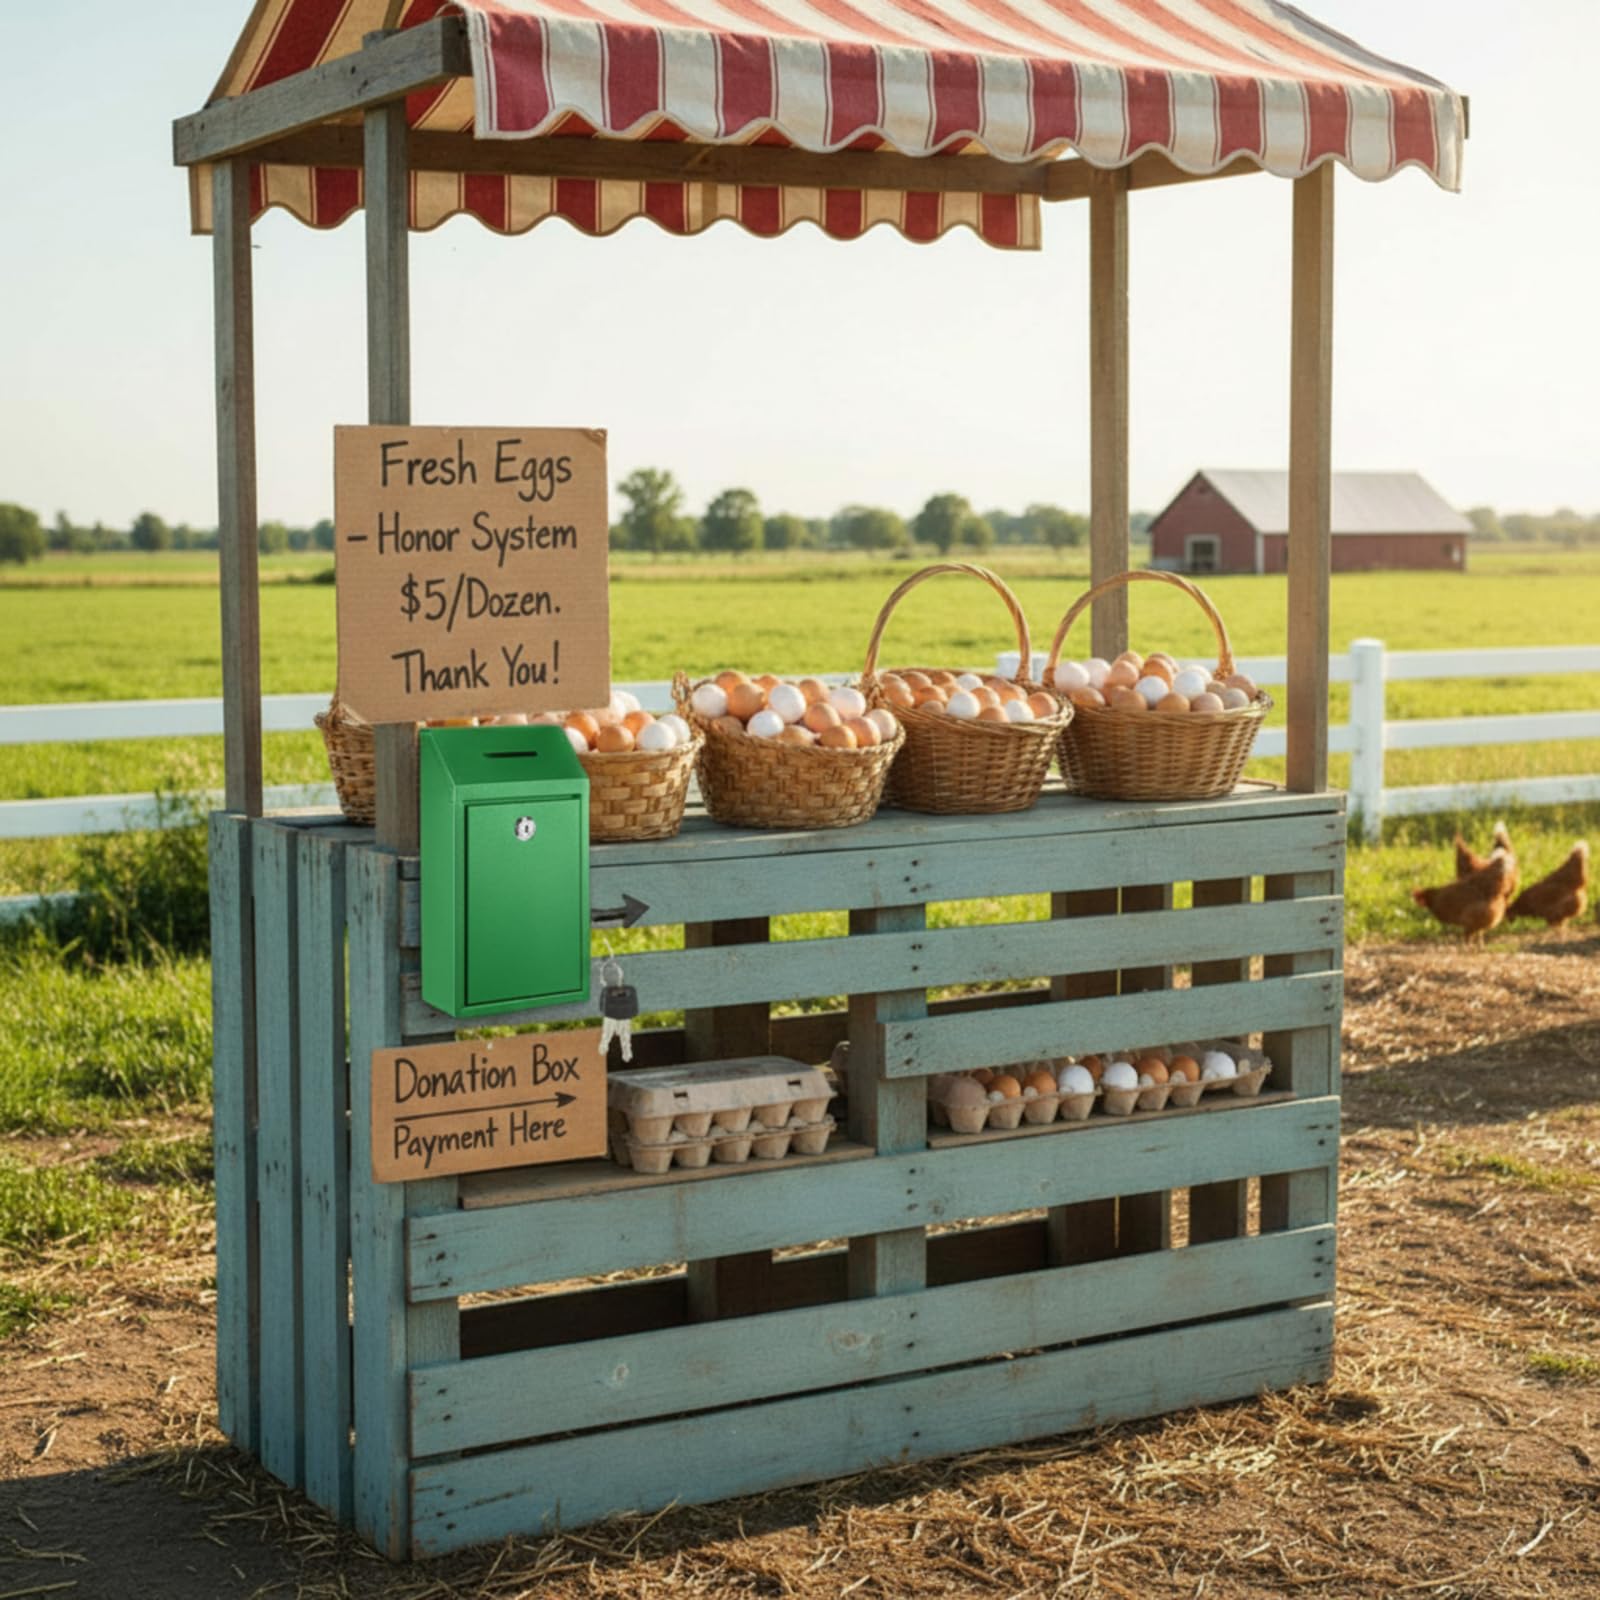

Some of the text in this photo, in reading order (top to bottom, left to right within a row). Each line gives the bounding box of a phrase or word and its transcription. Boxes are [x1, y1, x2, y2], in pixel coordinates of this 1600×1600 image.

[380, 438, 572, 502] Fresh Eggs
[378, 510, 460, 555] Honor
[471, 511, 577, 568] System
[400, 572, 561, 633] $5/Dozen.
[391, 639, 560, 694] Thank You!
[394, 1043, 580, 1103] Donation Box
[394, 1109, 566, 1169] Payment Here
